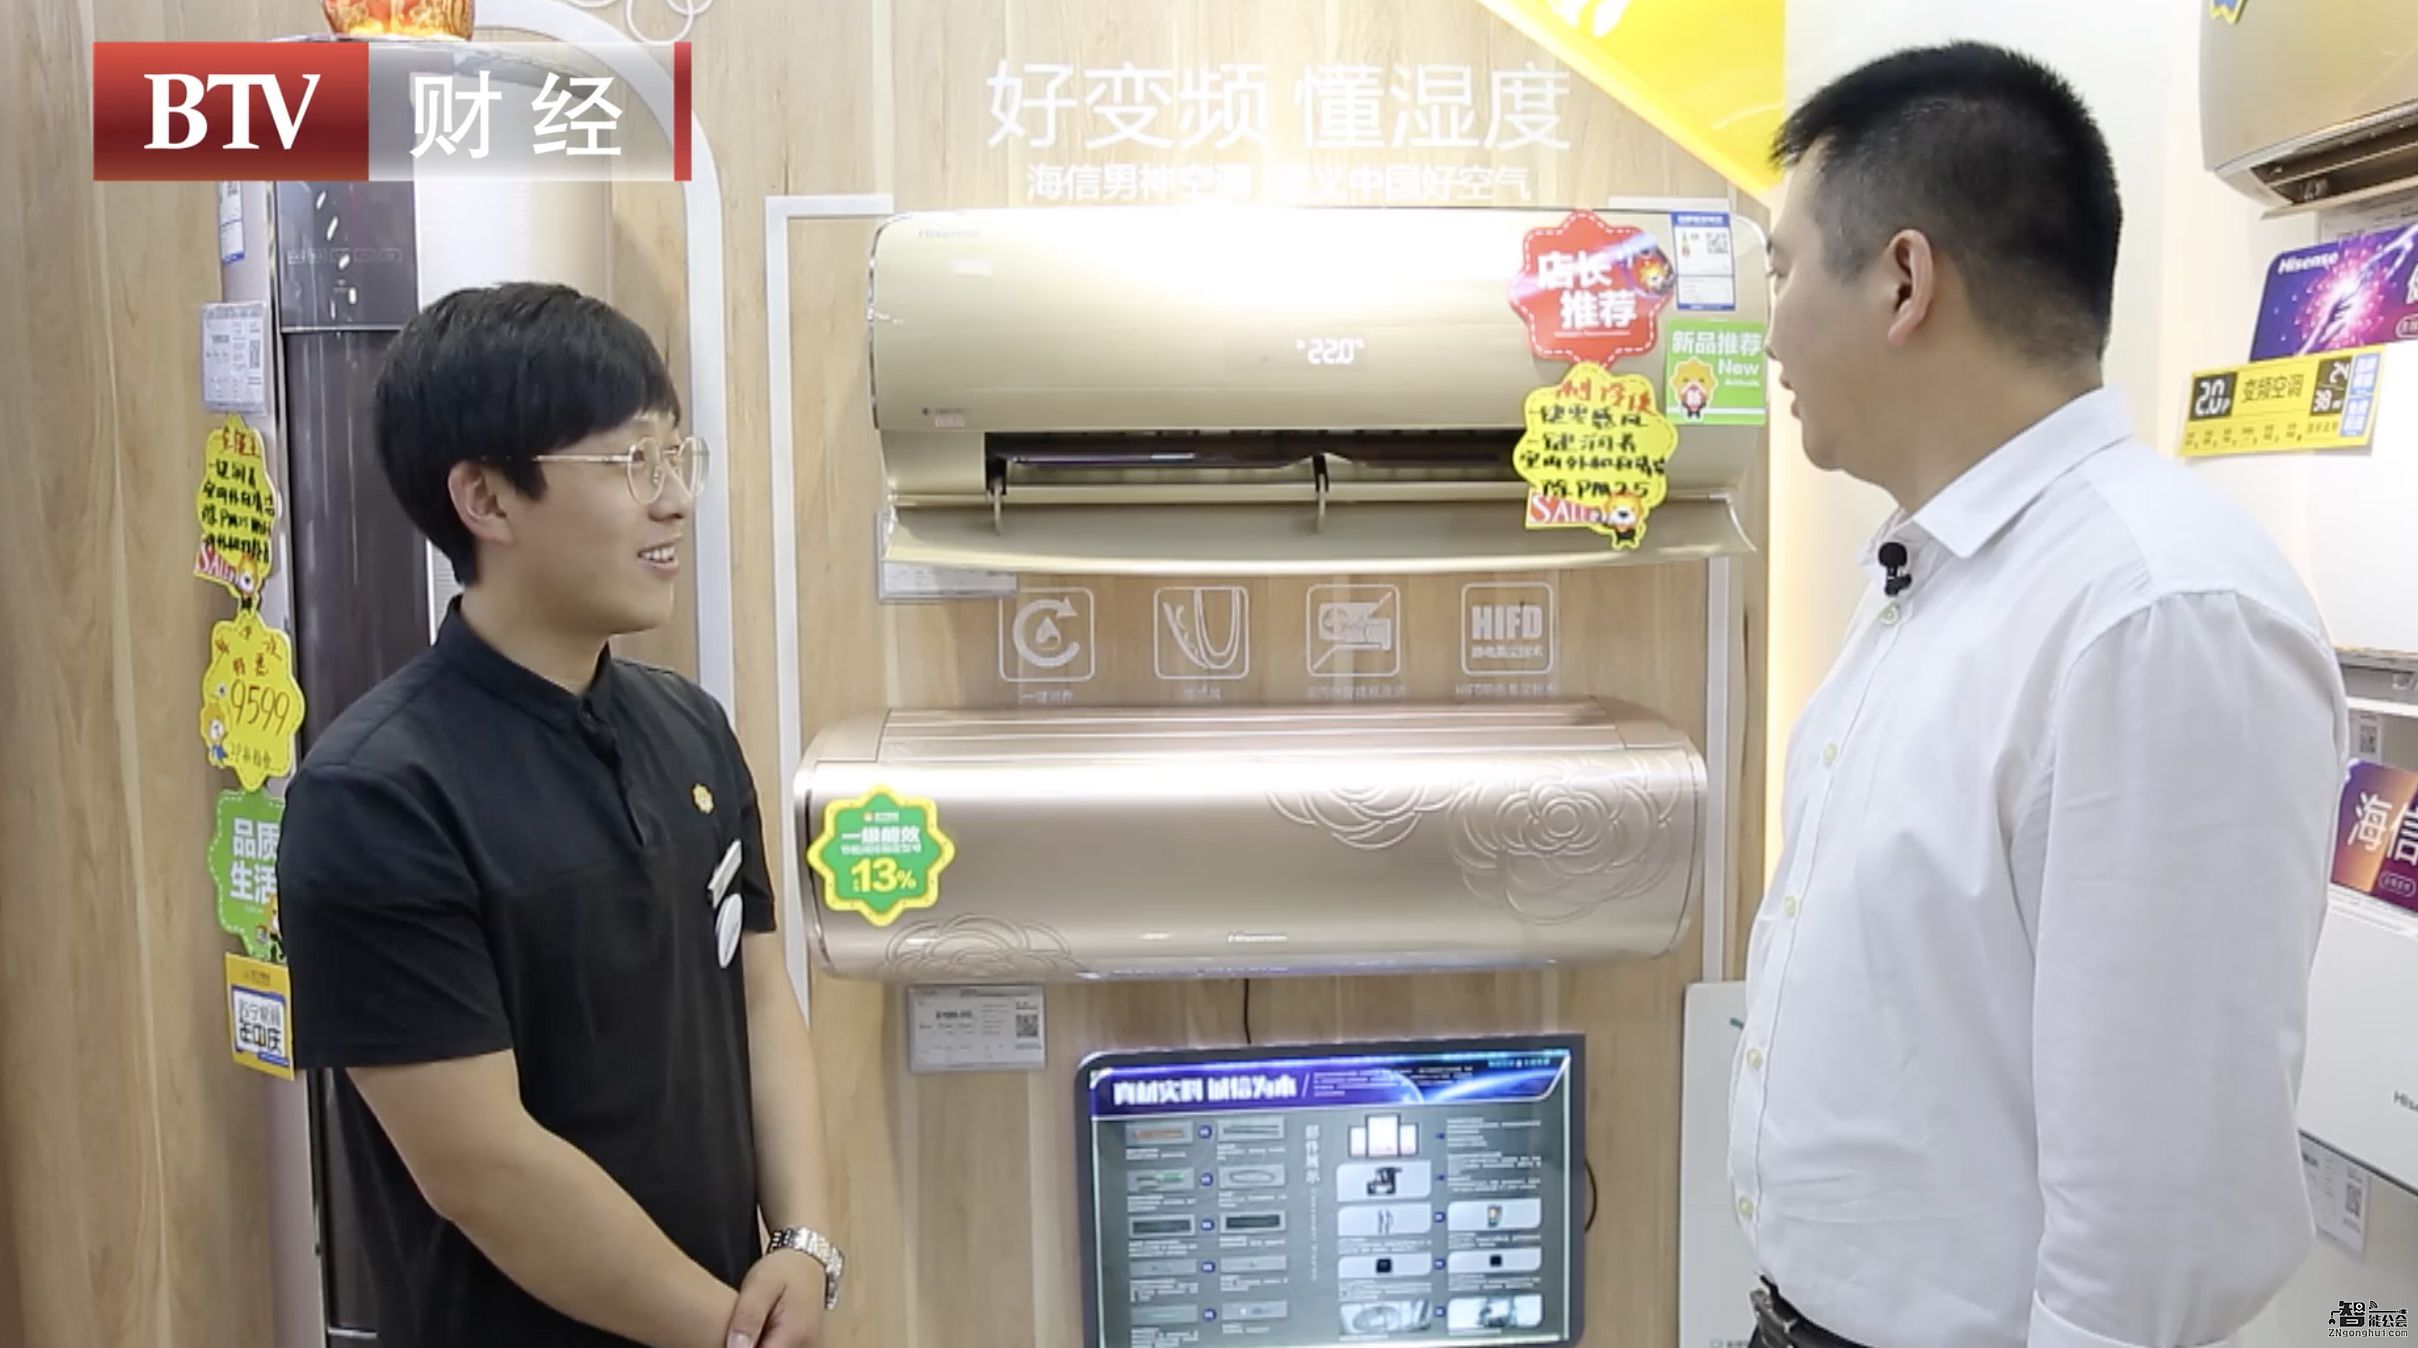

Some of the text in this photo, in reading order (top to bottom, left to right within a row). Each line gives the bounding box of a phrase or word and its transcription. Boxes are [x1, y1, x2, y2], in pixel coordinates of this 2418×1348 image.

[985, 60, 1572, 150] 好变频 懂湿度
[1270, 162, 1534, 201] 义中国好空气
[1536, 251, 1612, 288] 店长
[2277, 252, 2340, 275] Hisense
[1560, 291, 1637, 329] 推荐
[1671, 329, 1763, 355] 新品推荐
[1718, 358, 1760, 376] New
[2240, 373, 2306, 404] 变频空调
[1471, 604, 1543, 641] HIFD
[230, 677, 291, 737] 9599
[232, 817, 281, 860] 品质
[230, 860, 279, 905] 生活
[851, 857, 917, 893] 13%
